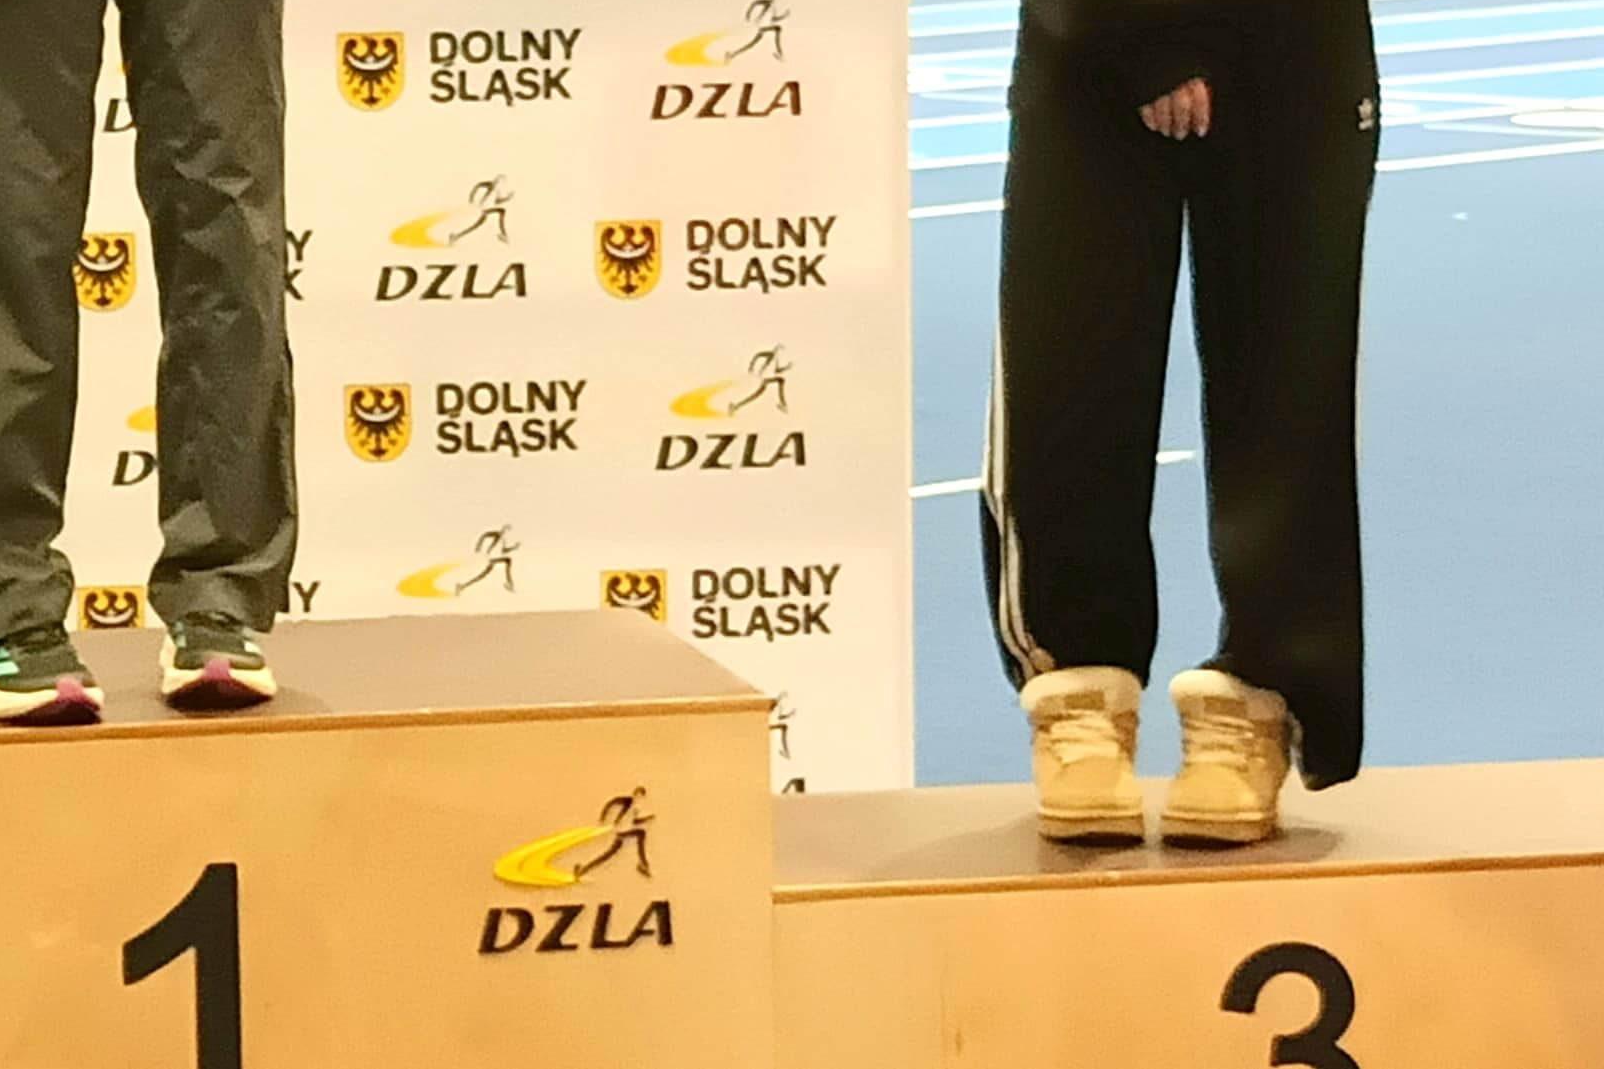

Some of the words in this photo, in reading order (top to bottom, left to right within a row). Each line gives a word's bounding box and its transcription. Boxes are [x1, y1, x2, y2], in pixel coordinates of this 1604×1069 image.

[431, 29, 581, 64] DOLNY
[431, 61, 570, 106] ŚLĄSK
[652, 81, 801, 119] DZLA
[687, 216, 835, 251] DOLNY
[376, 263, 526, 300] DZLA
[688, 248, 826, 293] ŚLĄSK
[437, 380, 586, 415] DOLNY
[437, 412, 576, 457] ŚLĄSK
[656, 432, 805, 470] DZLA
[693, 565, 839, 600] DOLNY
[693, 597, 830, 641] ŚLĄSK
[478, 900, 673, 955] DZLA
[122, 862, 242, 1069] 1
[1219, 940, 1356, 1069] 3
